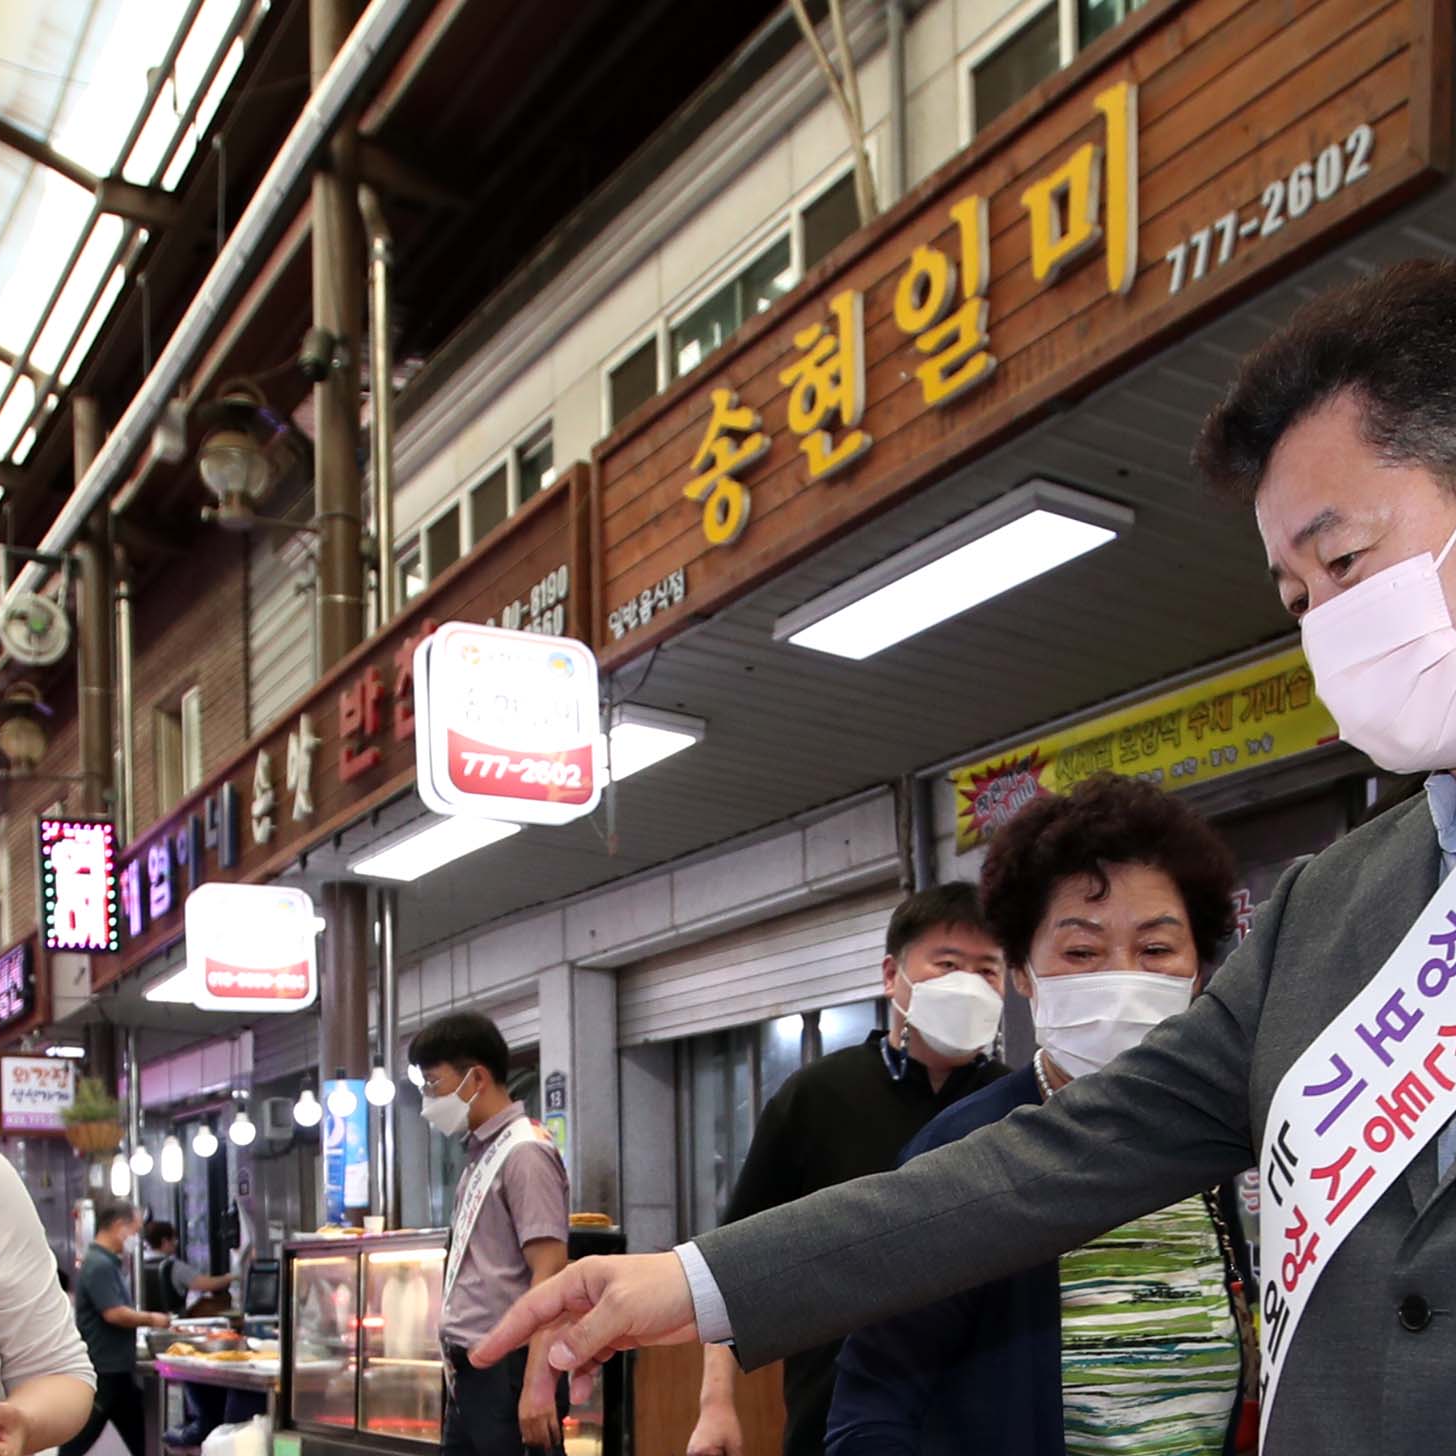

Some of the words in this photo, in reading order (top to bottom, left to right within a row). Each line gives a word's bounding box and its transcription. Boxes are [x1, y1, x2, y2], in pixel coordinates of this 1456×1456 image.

[1165, 124, 1376, 297] 777-2602
[682, 80, 1141, 548] 송현일미
[608, 567, 686, 640] 일반음식점
[460, 751, 582, 789] 777-2602
